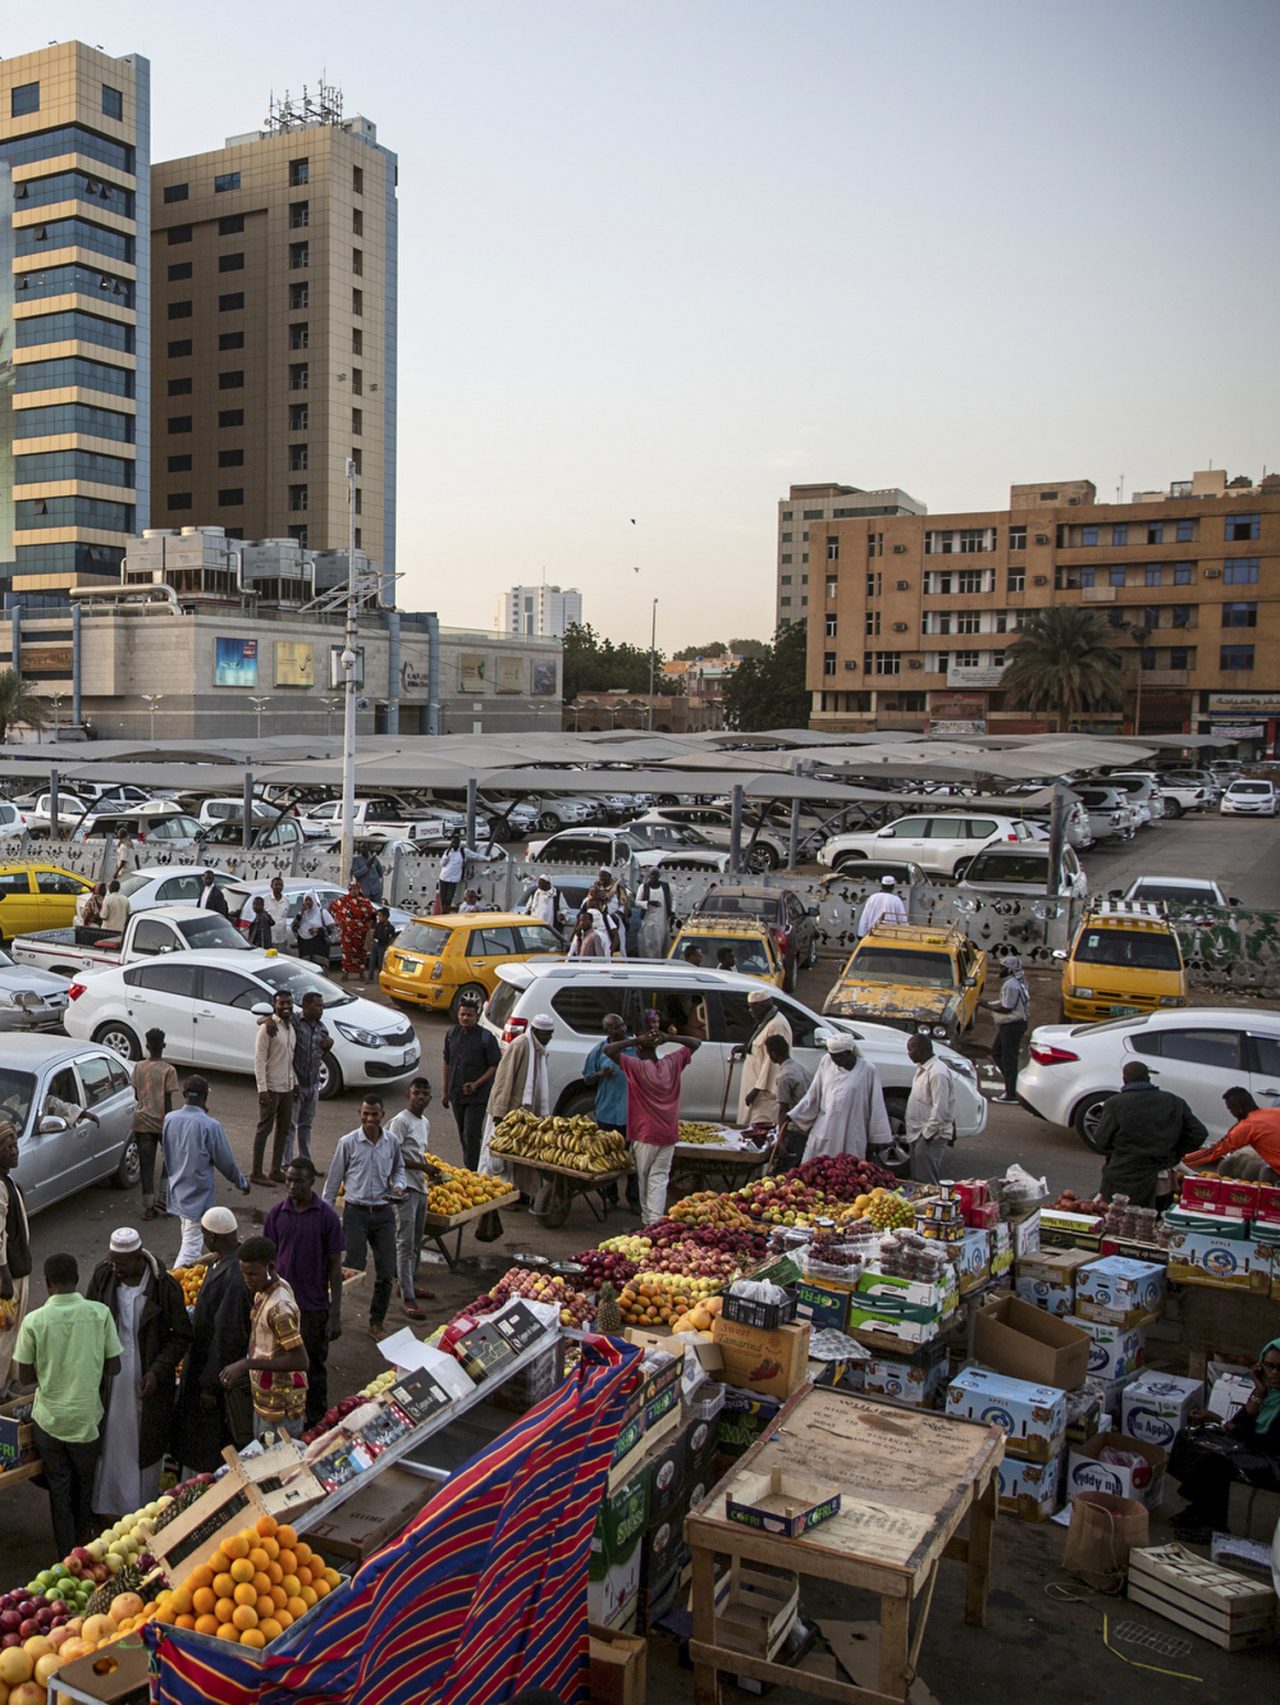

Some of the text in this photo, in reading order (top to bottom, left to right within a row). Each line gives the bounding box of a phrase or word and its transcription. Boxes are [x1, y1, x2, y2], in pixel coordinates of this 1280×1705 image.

[1211, 1239, 1231, 1248] APPLE
[800, 1288, 841, 1310] COFRI
[718, 1333, 763, 1353] Tamarind
[988, 1397, 1009, 1407] APPLE
[731, 1509, 761, 1527] COFRI
[806, 1503, 832, 1527] COFRI
